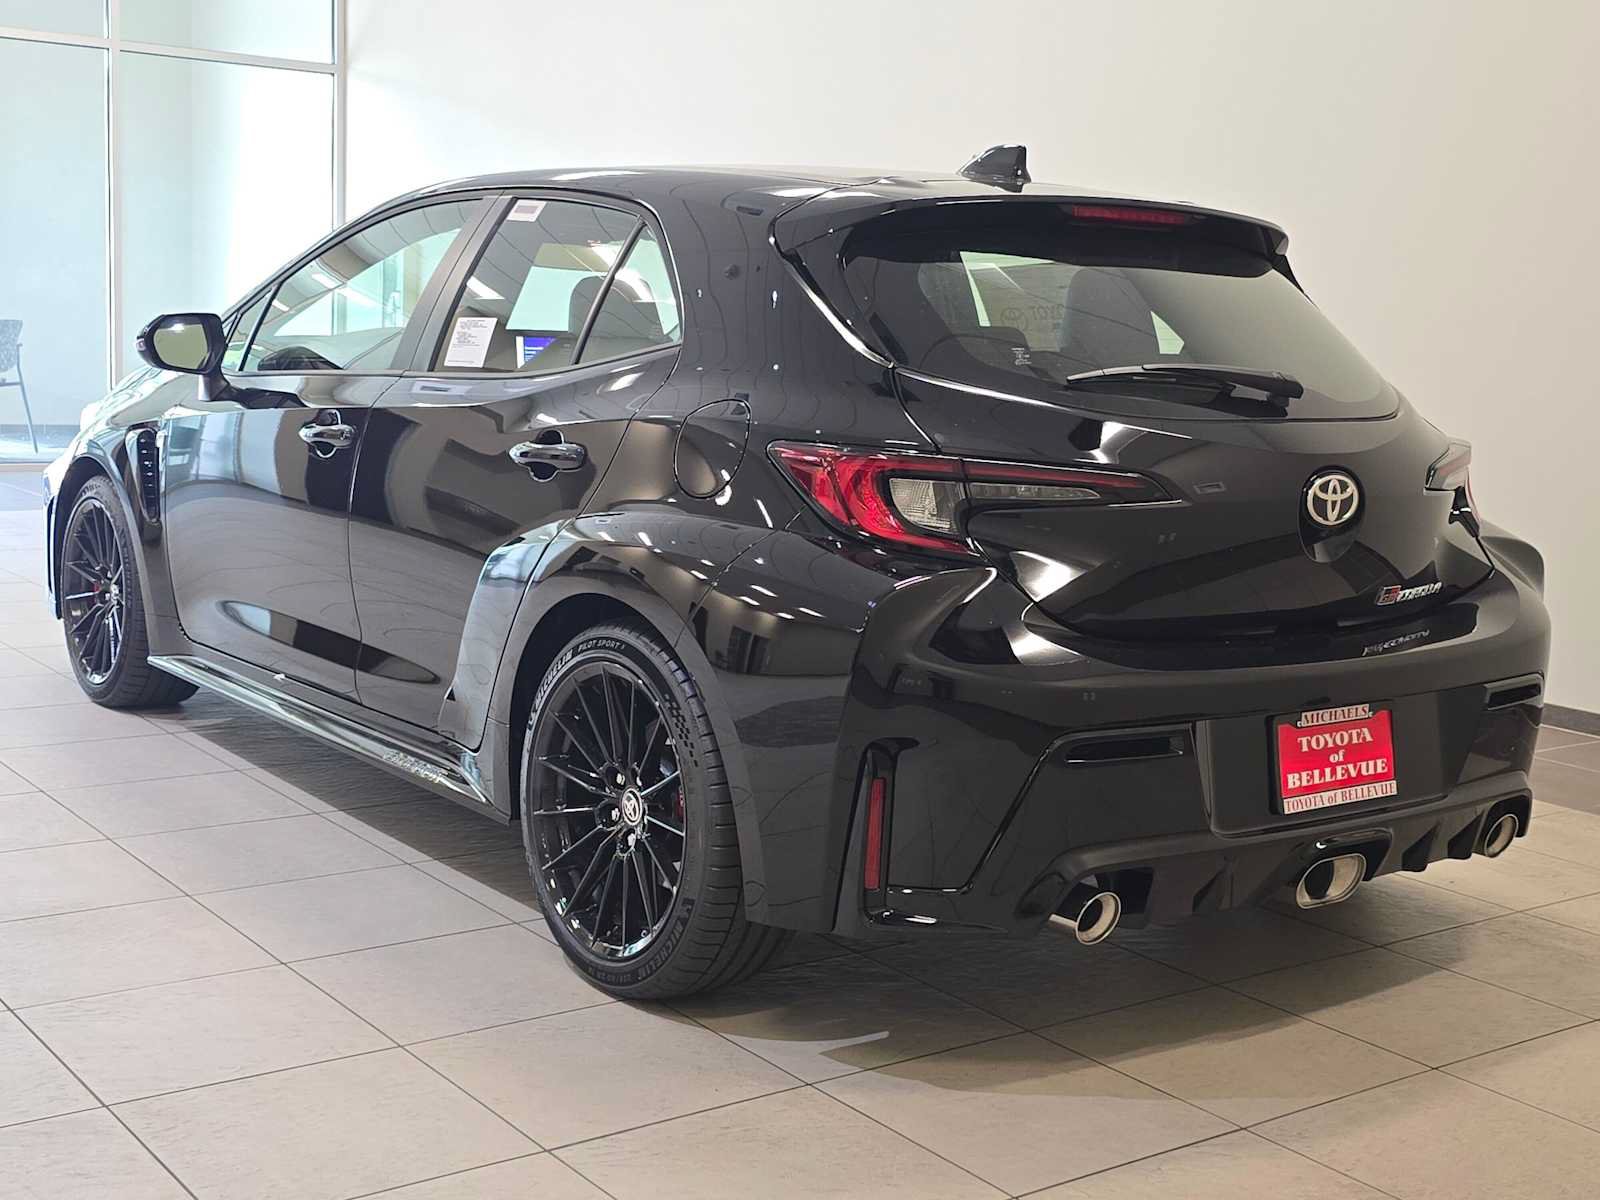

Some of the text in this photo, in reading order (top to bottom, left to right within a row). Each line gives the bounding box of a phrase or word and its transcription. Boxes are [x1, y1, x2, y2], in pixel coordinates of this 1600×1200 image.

[535, 649, 574, 709] MICHELIN
[578, 640, 597, 652] PILOT
[597, 639, 620, 650] SPORT
[1302, 705, 1368, 724] MICHAELS
[1297, 727, 1373, 752] TOYOTA
[1329, 749, 1345, 763] of
[1287, 758, 1388, 789] BELLEVUE
[1286, 781, 1394, 813] TOYOTA of BELLEVUE
